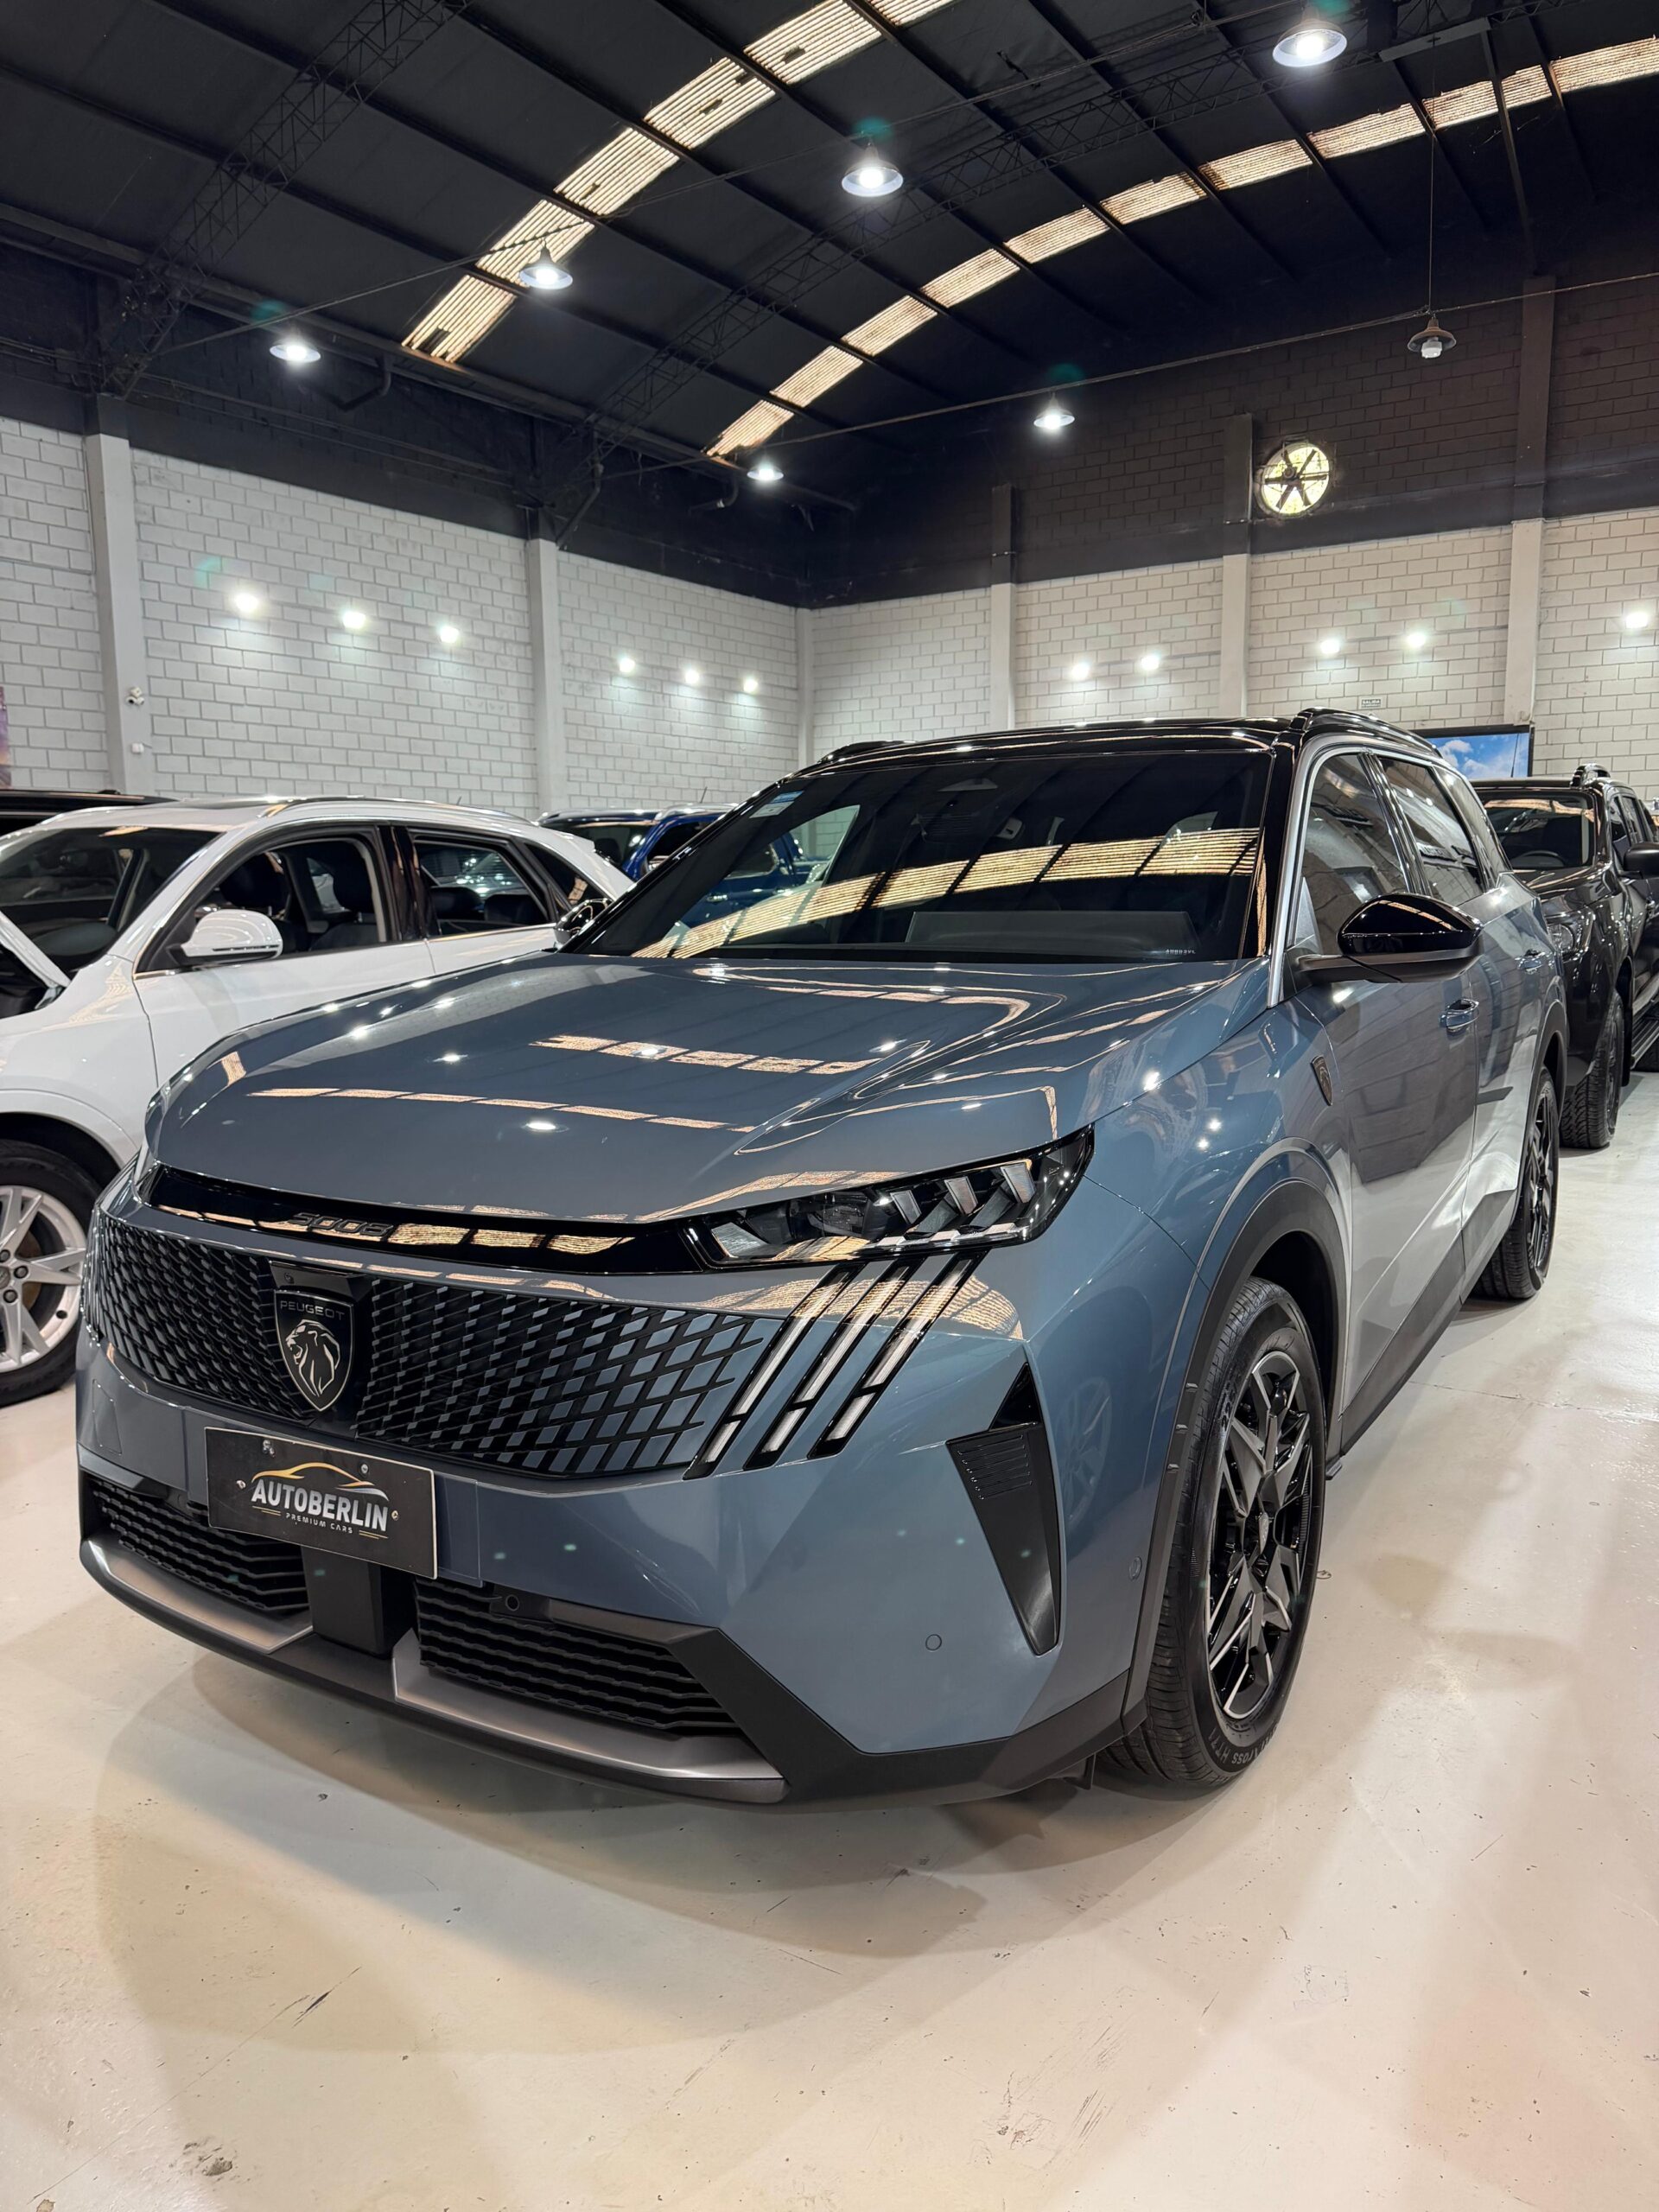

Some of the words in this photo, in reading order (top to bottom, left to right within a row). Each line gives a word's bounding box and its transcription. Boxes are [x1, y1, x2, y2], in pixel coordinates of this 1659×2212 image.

[288, 1212, 393, 1236] 5008
[280, 1300, 345, 1320] PEUGEOT
[251, 1478, 388, 1531] AUTOBERLIN
[286, 1513, 326, 1527] PREMIUM
[331, 1523, 353, 1534] CARS
